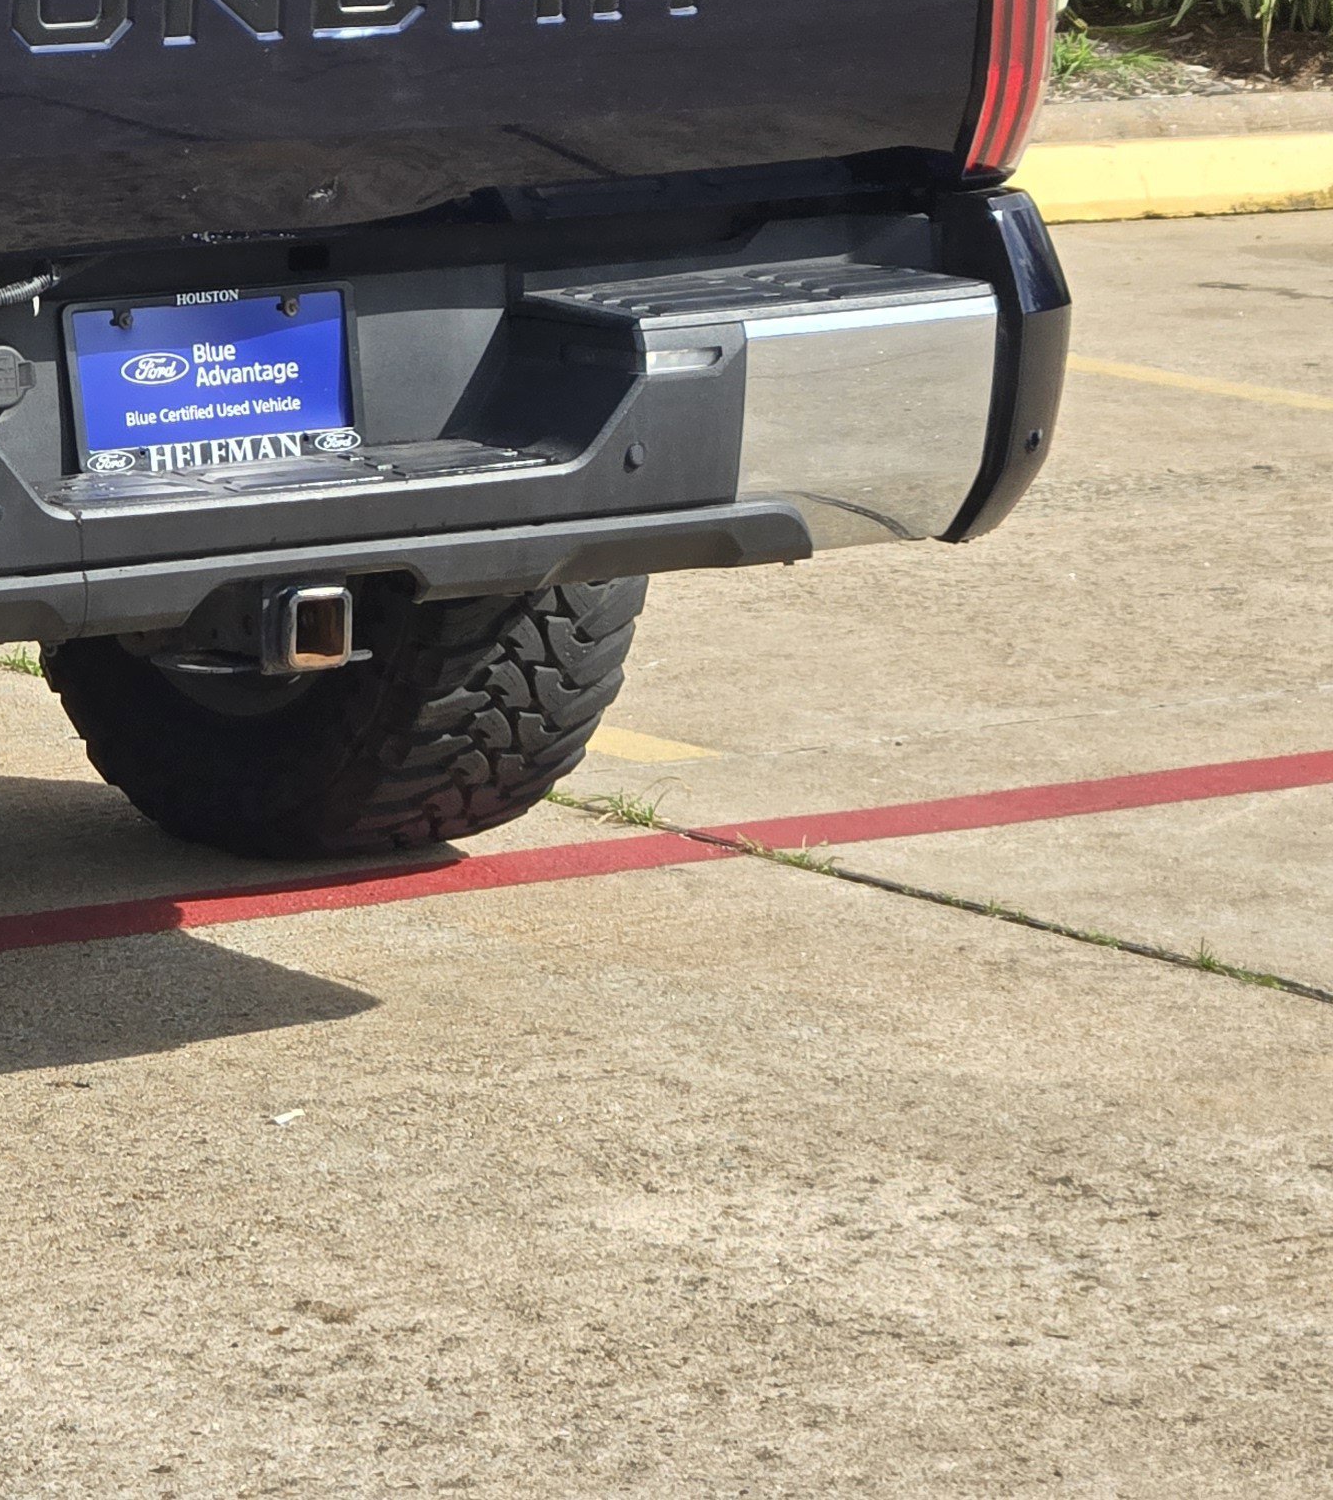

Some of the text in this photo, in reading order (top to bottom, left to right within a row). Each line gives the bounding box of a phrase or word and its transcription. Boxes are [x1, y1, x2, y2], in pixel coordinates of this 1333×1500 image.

[175, 288, 240, 306] HOUSTON
[193, 343, 237, 364] Blue
[135, 357, 177, 380] Ford
[195, 358, 300, 389] Advantage
[125, 396, 302, 427] Blue Certified Used Vehicle
[149, 432, 304, 472] HELFMAN
[321, 433, 354, 449] Ford
[94, 454, 127, 471] Ford
